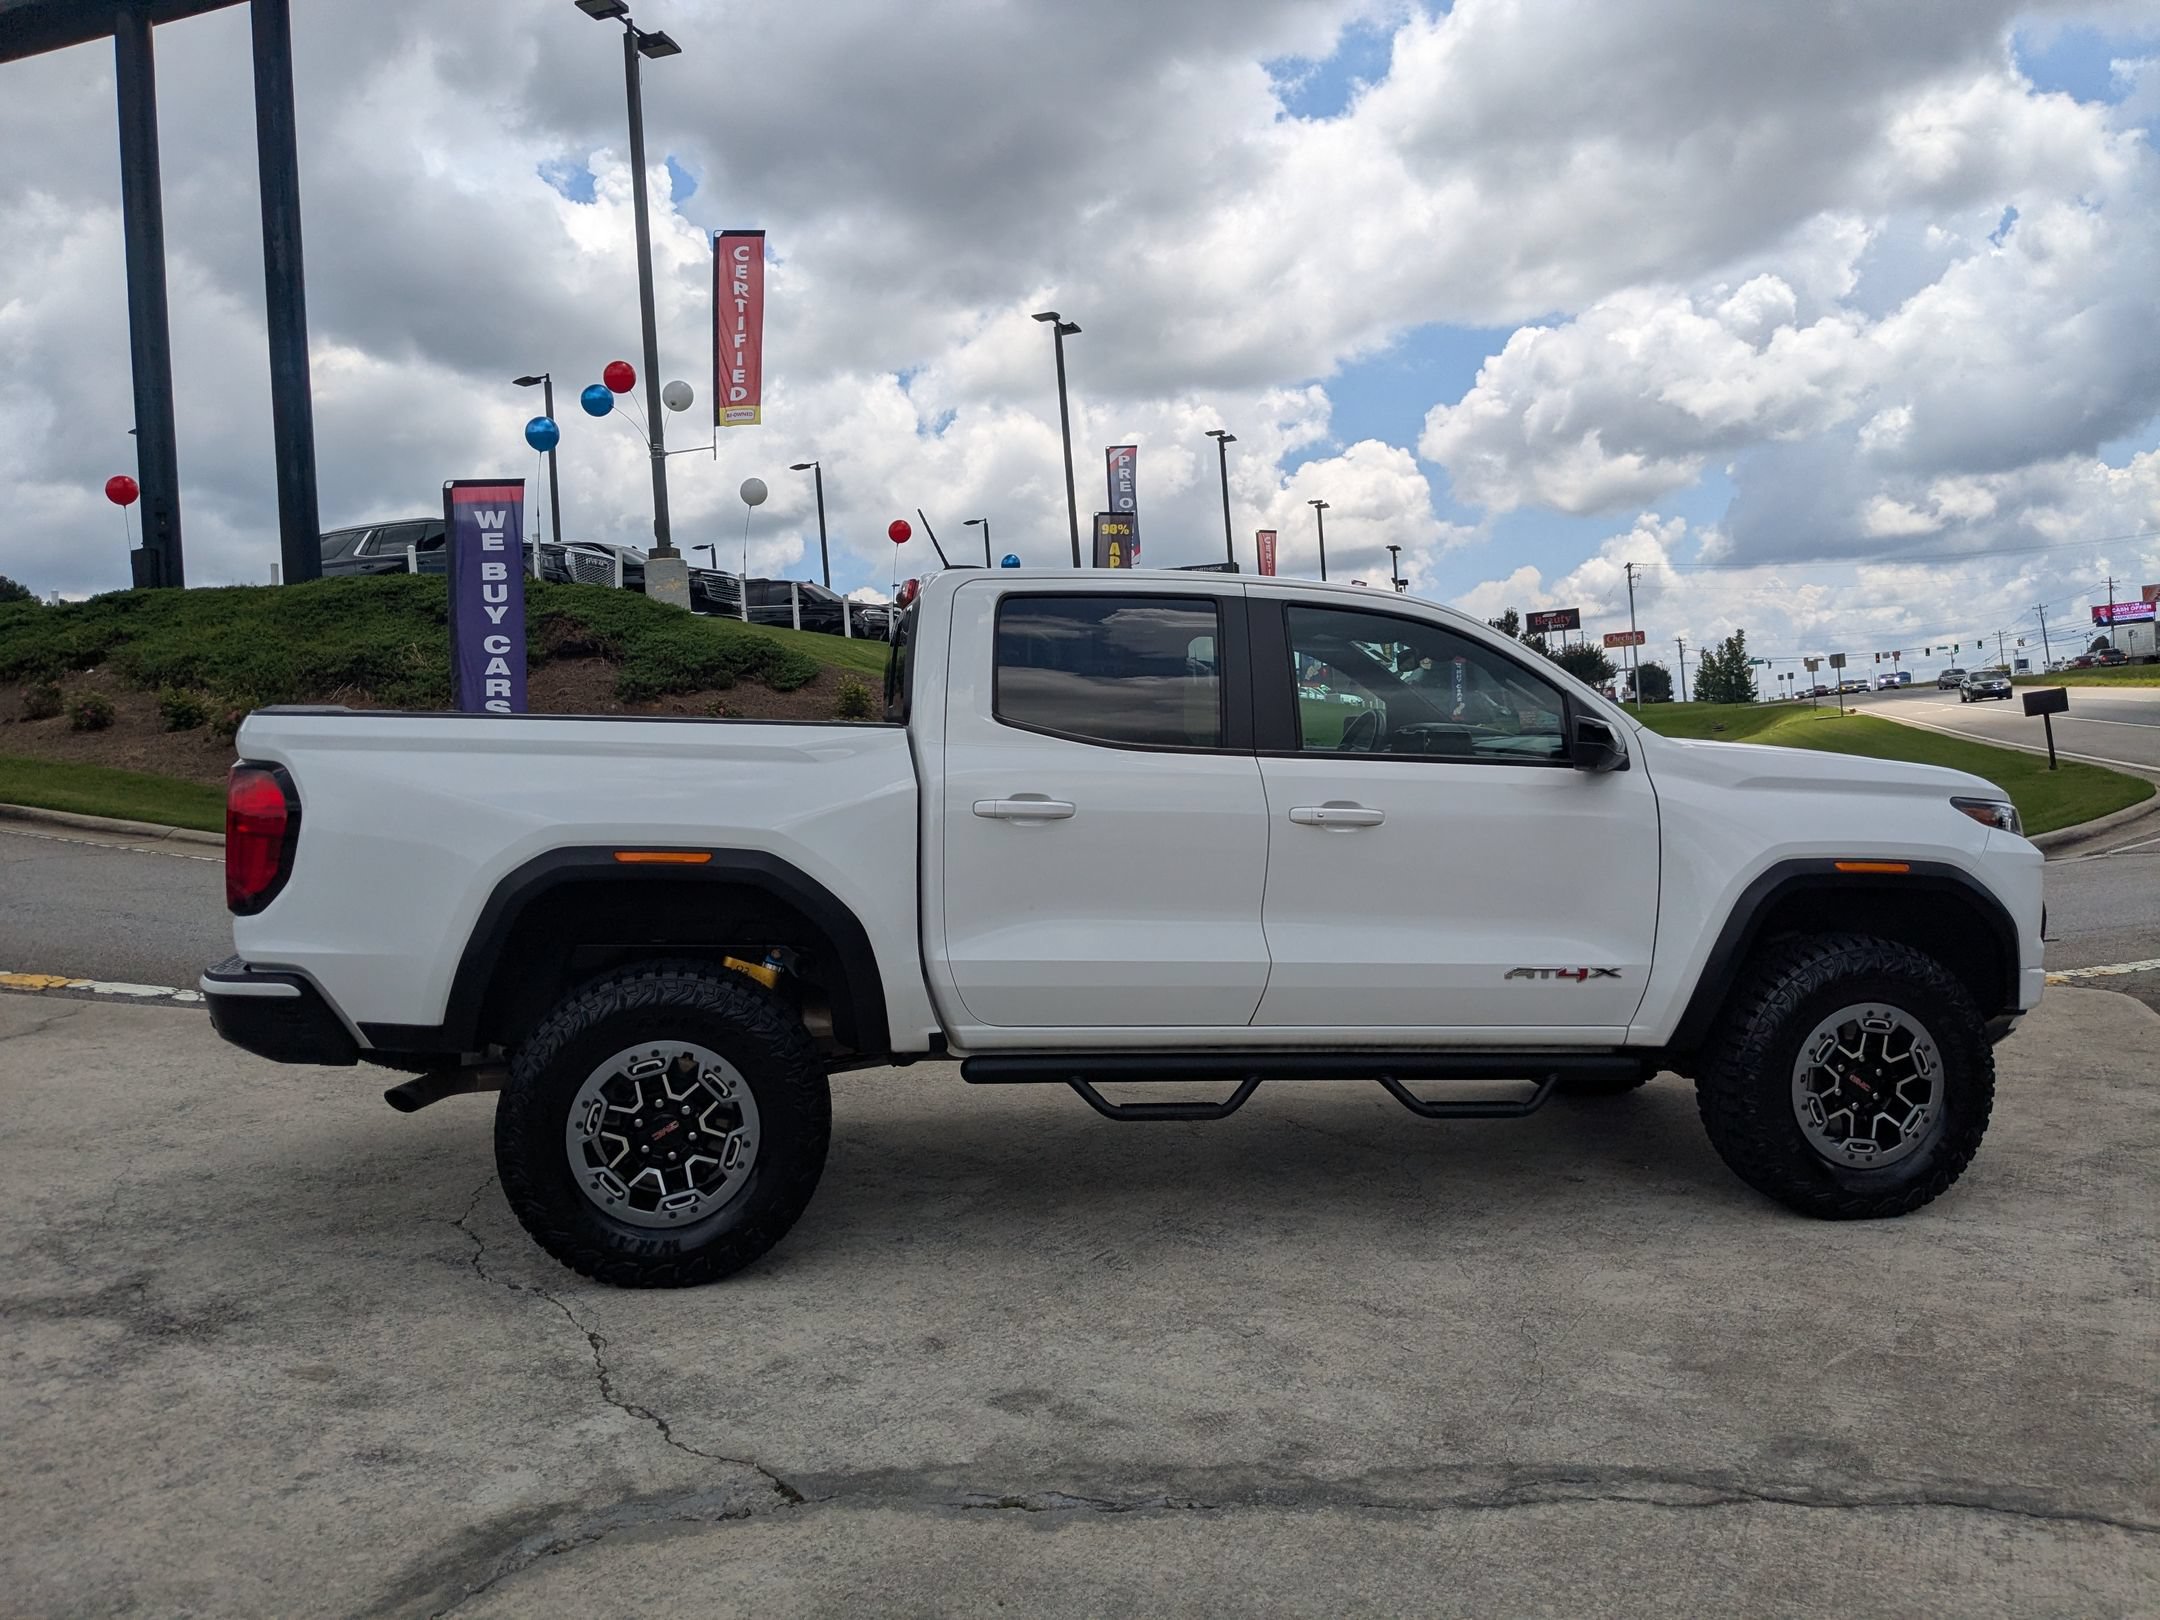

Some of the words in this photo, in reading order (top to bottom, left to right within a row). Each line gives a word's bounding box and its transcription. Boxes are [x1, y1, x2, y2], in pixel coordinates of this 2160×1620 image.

[730, 246, 750, 402] CERTIFIED
[1119, 455, 1132, 492] PRE
[474, 510, 507, 551] WE
[1101, 524, 1130, 535] 98%
[481, 562, 509, 625] BUY
[1504, 966, 1622, 983] AT4X
